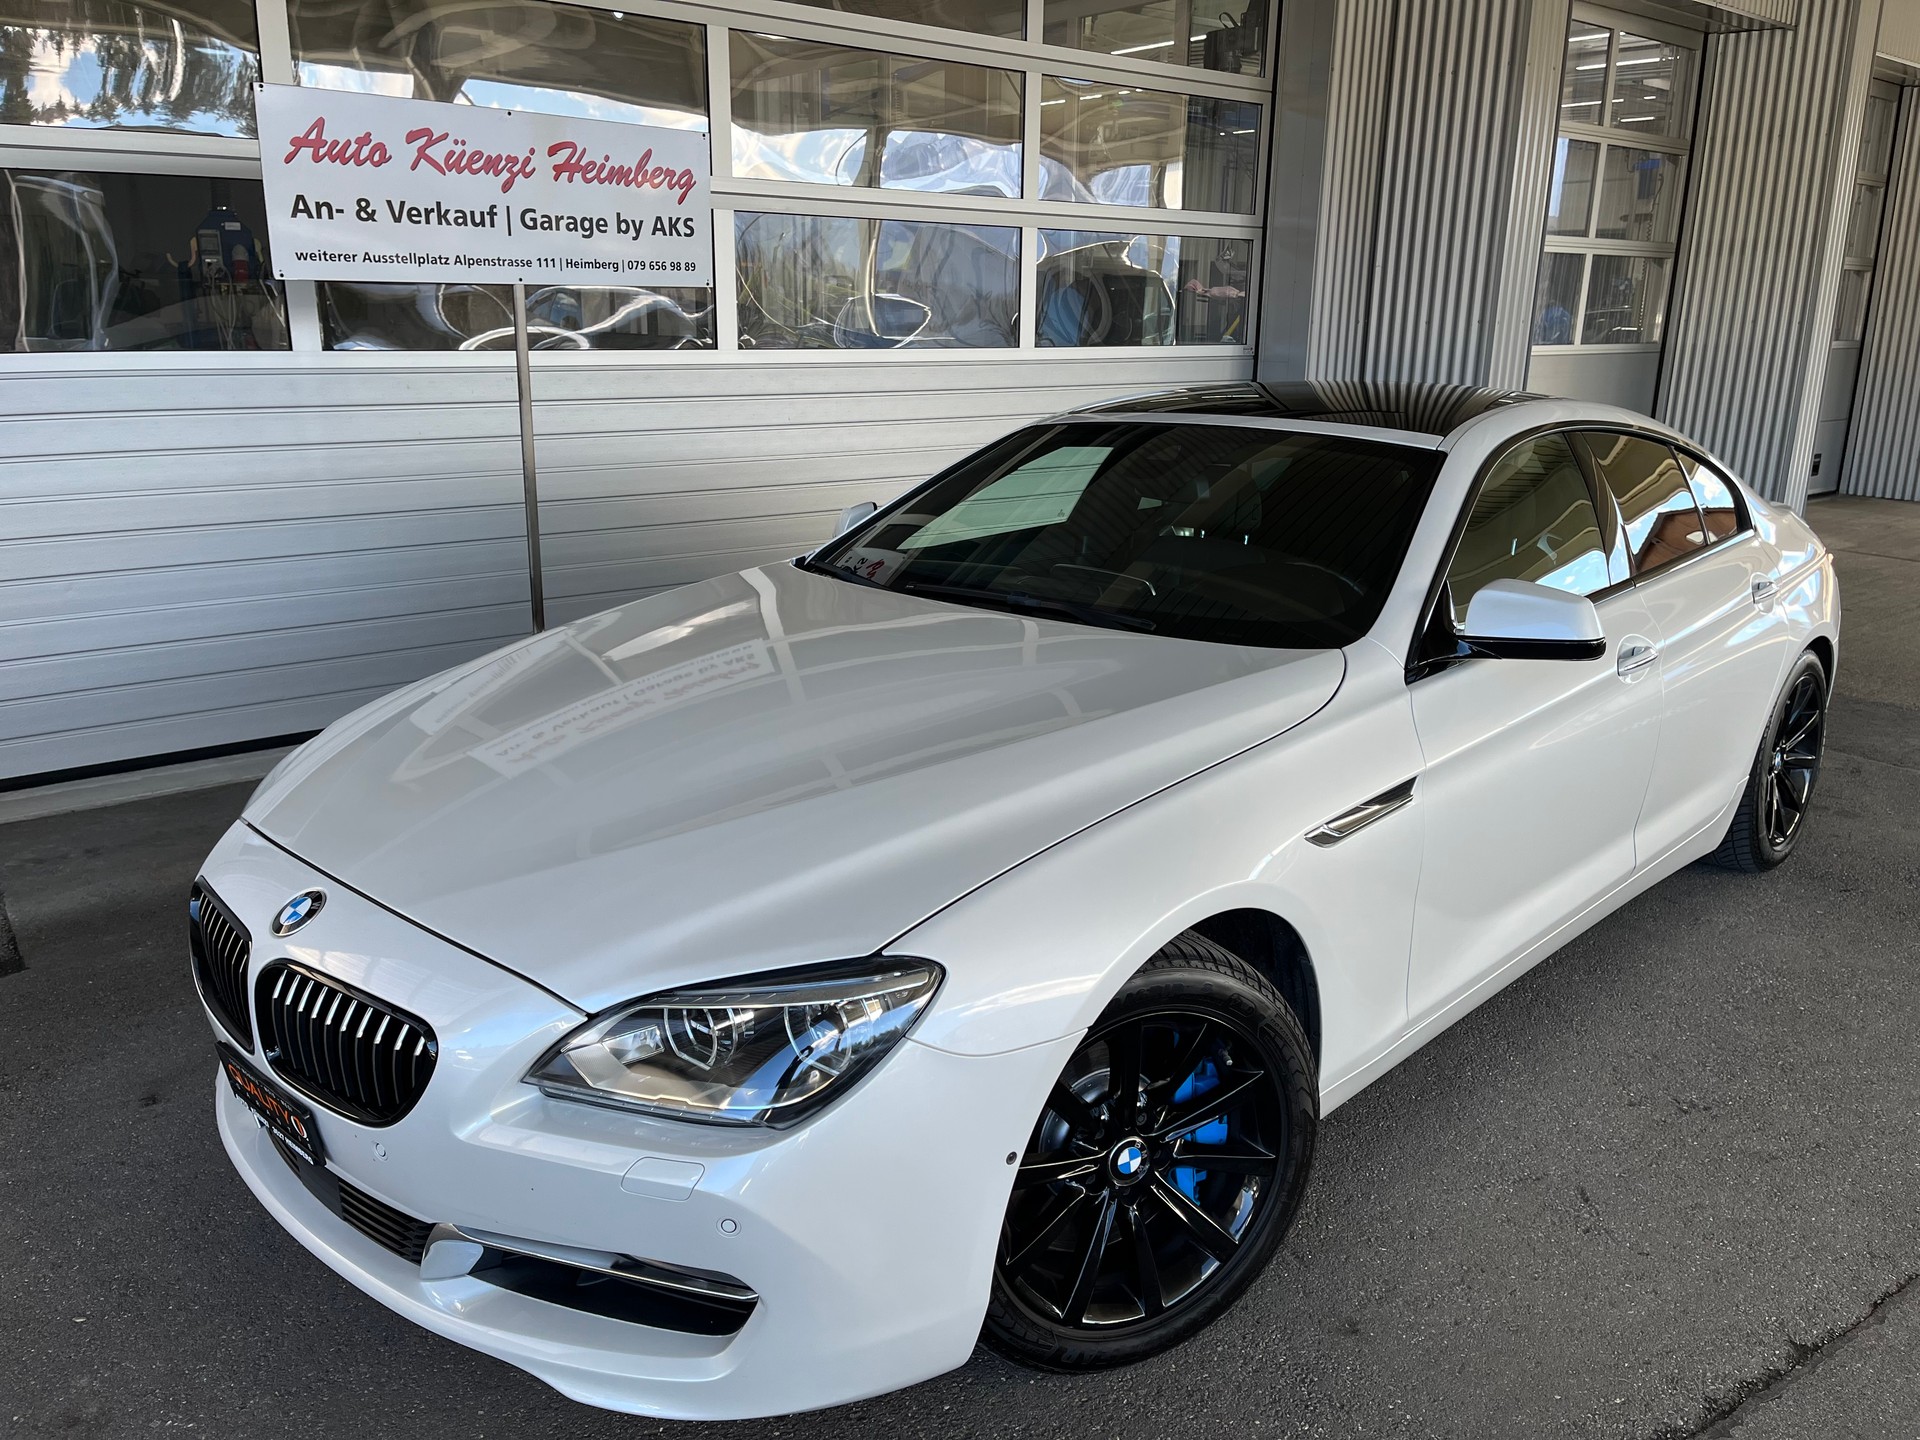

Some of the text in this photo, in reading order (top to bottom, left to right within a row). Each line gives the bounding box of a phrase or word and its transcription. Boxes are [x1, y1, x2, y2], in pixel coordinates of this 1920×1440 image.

[283, 116, 698, 206] Auto Küenzi Heimberg
[290, 194, 345, 221] An-
[355, 197, 378, 223] &
[385, 199, 498, 229] Verkauf
[519, 207, 609, 240] Garage
[615, 211, 645, 241] by
[651, 216, 696, 238] AKS
[294, 250, 358, 264] weiterer
[362, 250, 451, 268] Ausstellplatz
[453, 254, 533, 270] Alpenstrasse
[536, 257, 557, 269] 111
[565, 258, 619, 273] Heimberg
[627, 260, 646, 272] 079
[648, 260, 667, 272] 656
[669, 261, 682, 272] 98
[683, 261, 697, 273] 89
